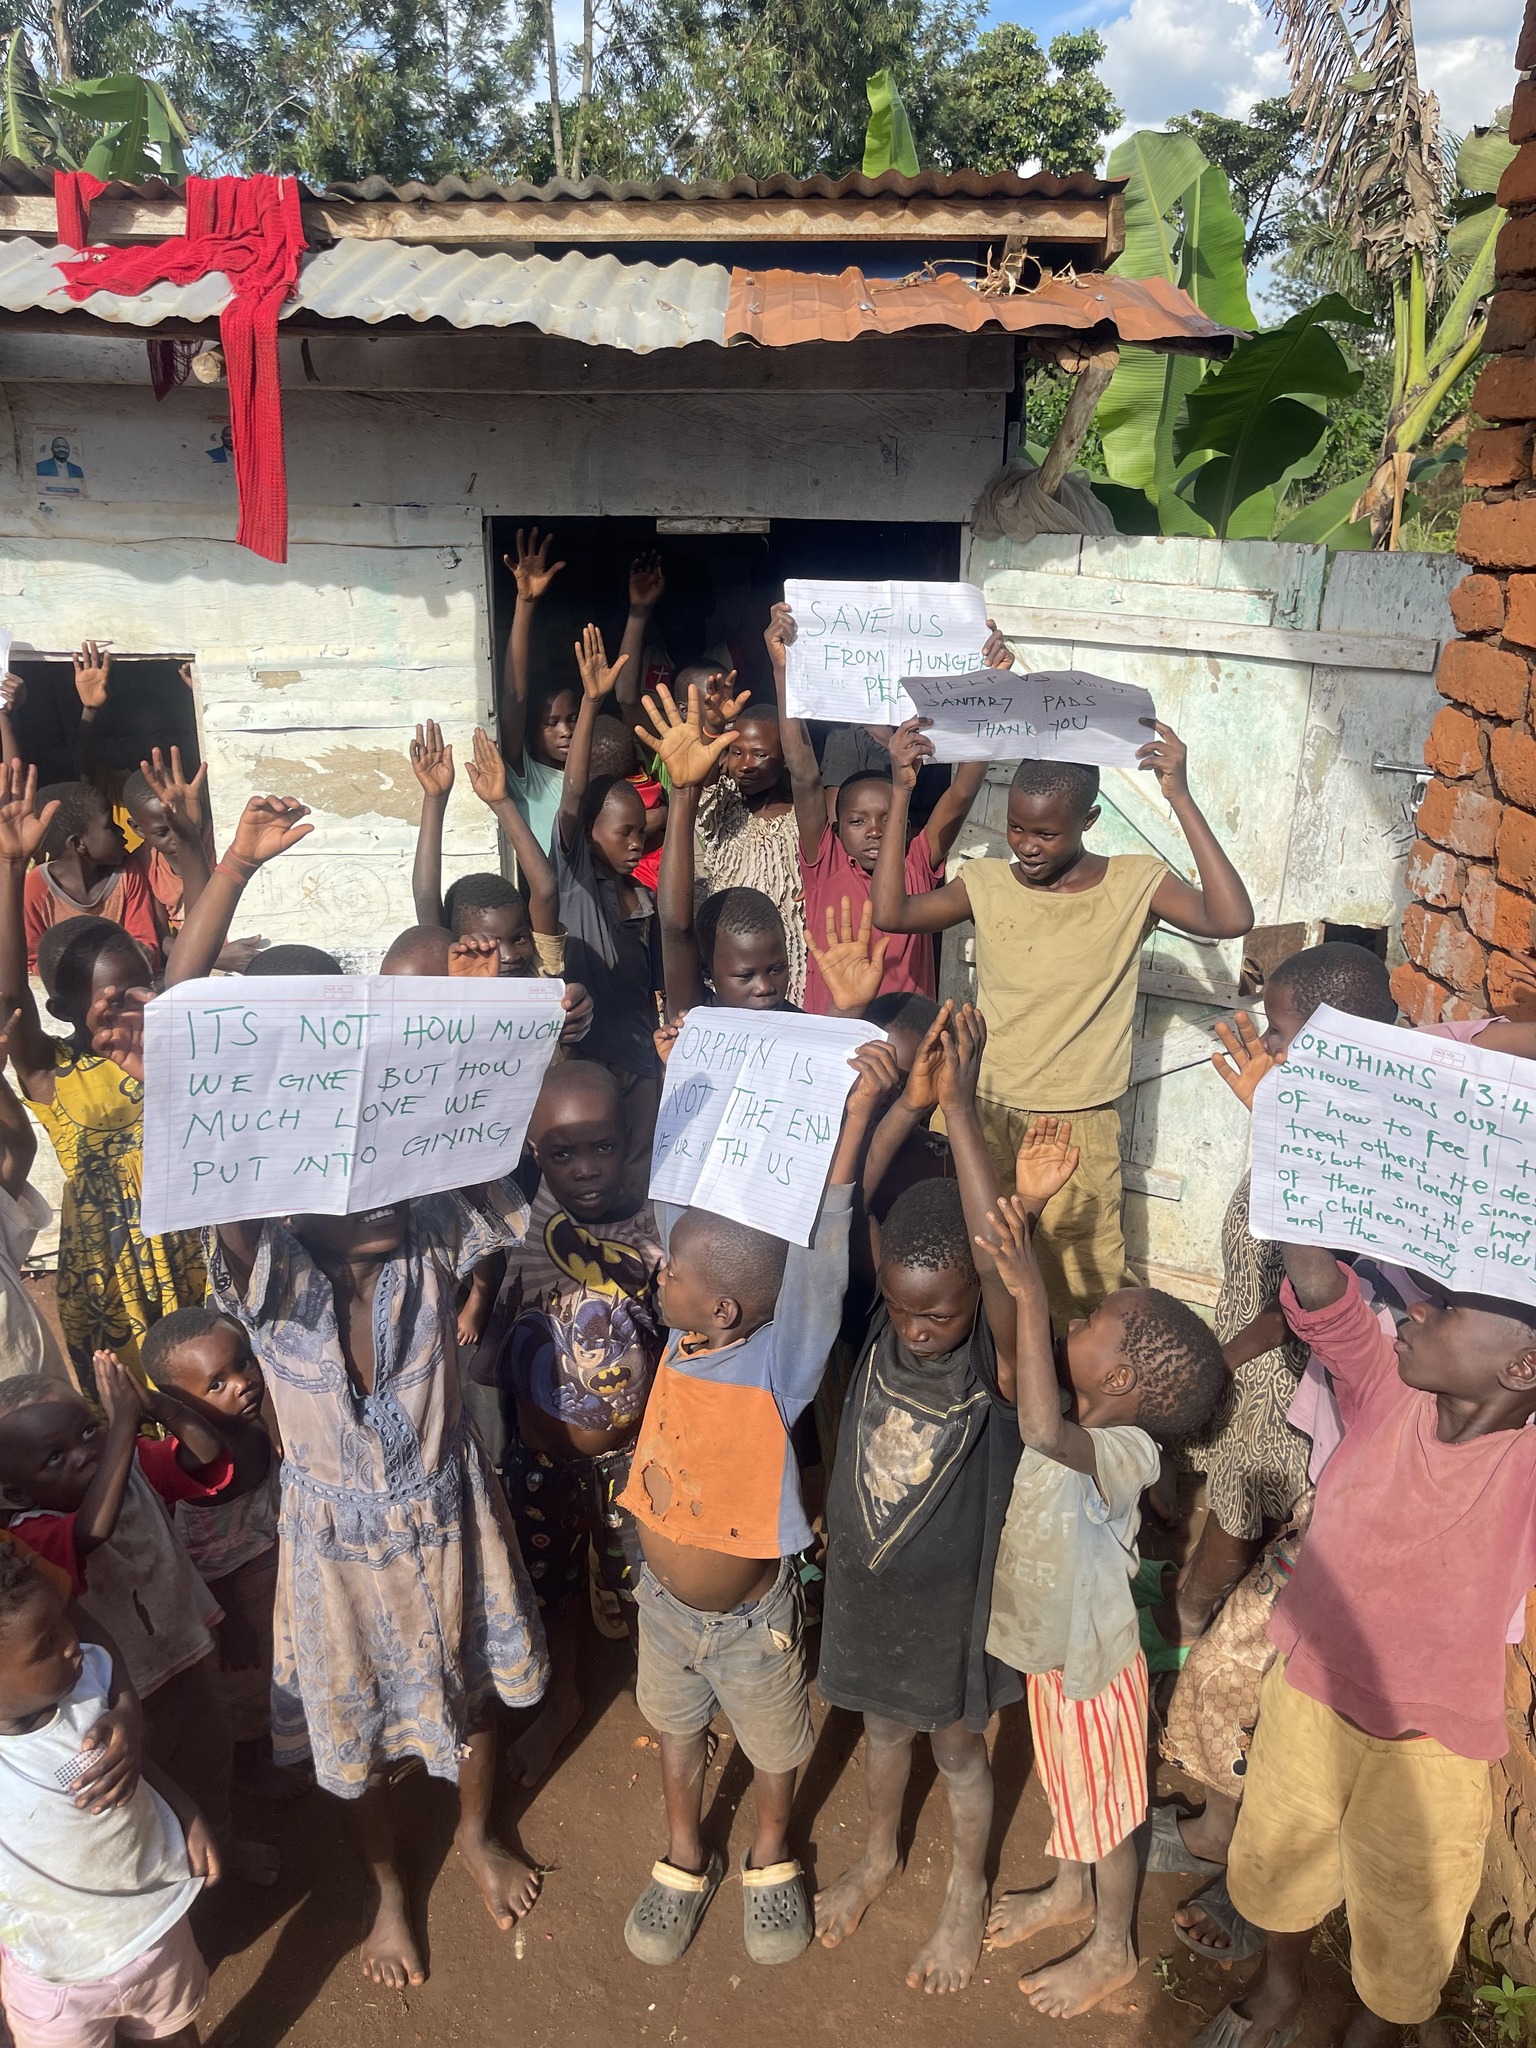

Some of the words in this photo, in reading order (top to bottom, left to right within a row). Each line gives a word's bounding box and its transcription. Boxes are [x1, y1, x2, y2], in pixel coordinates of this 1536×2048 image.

[806, 600, 895, 637] SAVE
[907, 613, 944, 638] US
[823, 644, 886, 673] FROM
[1042, 695, 1097, 713] PADS
[967, 718, 1036, 739] THANK
[1048, 715, 1088, 741] YOU
[187, 1005, 259, 1060] ITS
[299, 1013, 381, 1051] NOT
[404, 1014, 475, 1050] HOW
[490, 1019, 563, 1041] MUCH
[681, 1024, 778, 1071] ORPHAN
[788, 1051, 814, 1085] IS
[189, 1072, 255, 1097] WE
[278, 1069, 362, 1093] GIVE
[378, 1062, 448, 1092] BUT
[458, 1058, 521, 1082] HOW
[182, 1108, 301, 1150] MUCH
[334, 1095, 427, 1129] LOVE
[444, 1089, 493, 1115] WE
[664, 1082, 720, 1119] NOT
[726, 1085, 784, 1134] THE
[786, 1108, 832, 1145] END
[1325, 1100, 1372, 1125] how
[1382, 1117, 1413, 1137] to
[1459, 1077, 1534, 1124] 13:4
[191, 1155, 270, 1196] PUT
[293, 1145, 378, 1177] INTO
[402, 1122, 512, 1157] GIVING
[767, 1151, 794, 1186] US
[1285, 1117, 1349, 1149] treat
[1449, 1171, 1489, 1195] He
[1380, 1163, 1404, 1182] He
[1282, 1188, 1310, 1212] for
[1419, 1223, 1461, 1253] the
[1286, 1209, 1325, 1235] and
[1342, 1215, 1386, 1244] the
[1321, 1172, 1377, 1197] their
[1442, 1211, 1475, 1235] He
[1489, 1220, 1531, 1249] had
